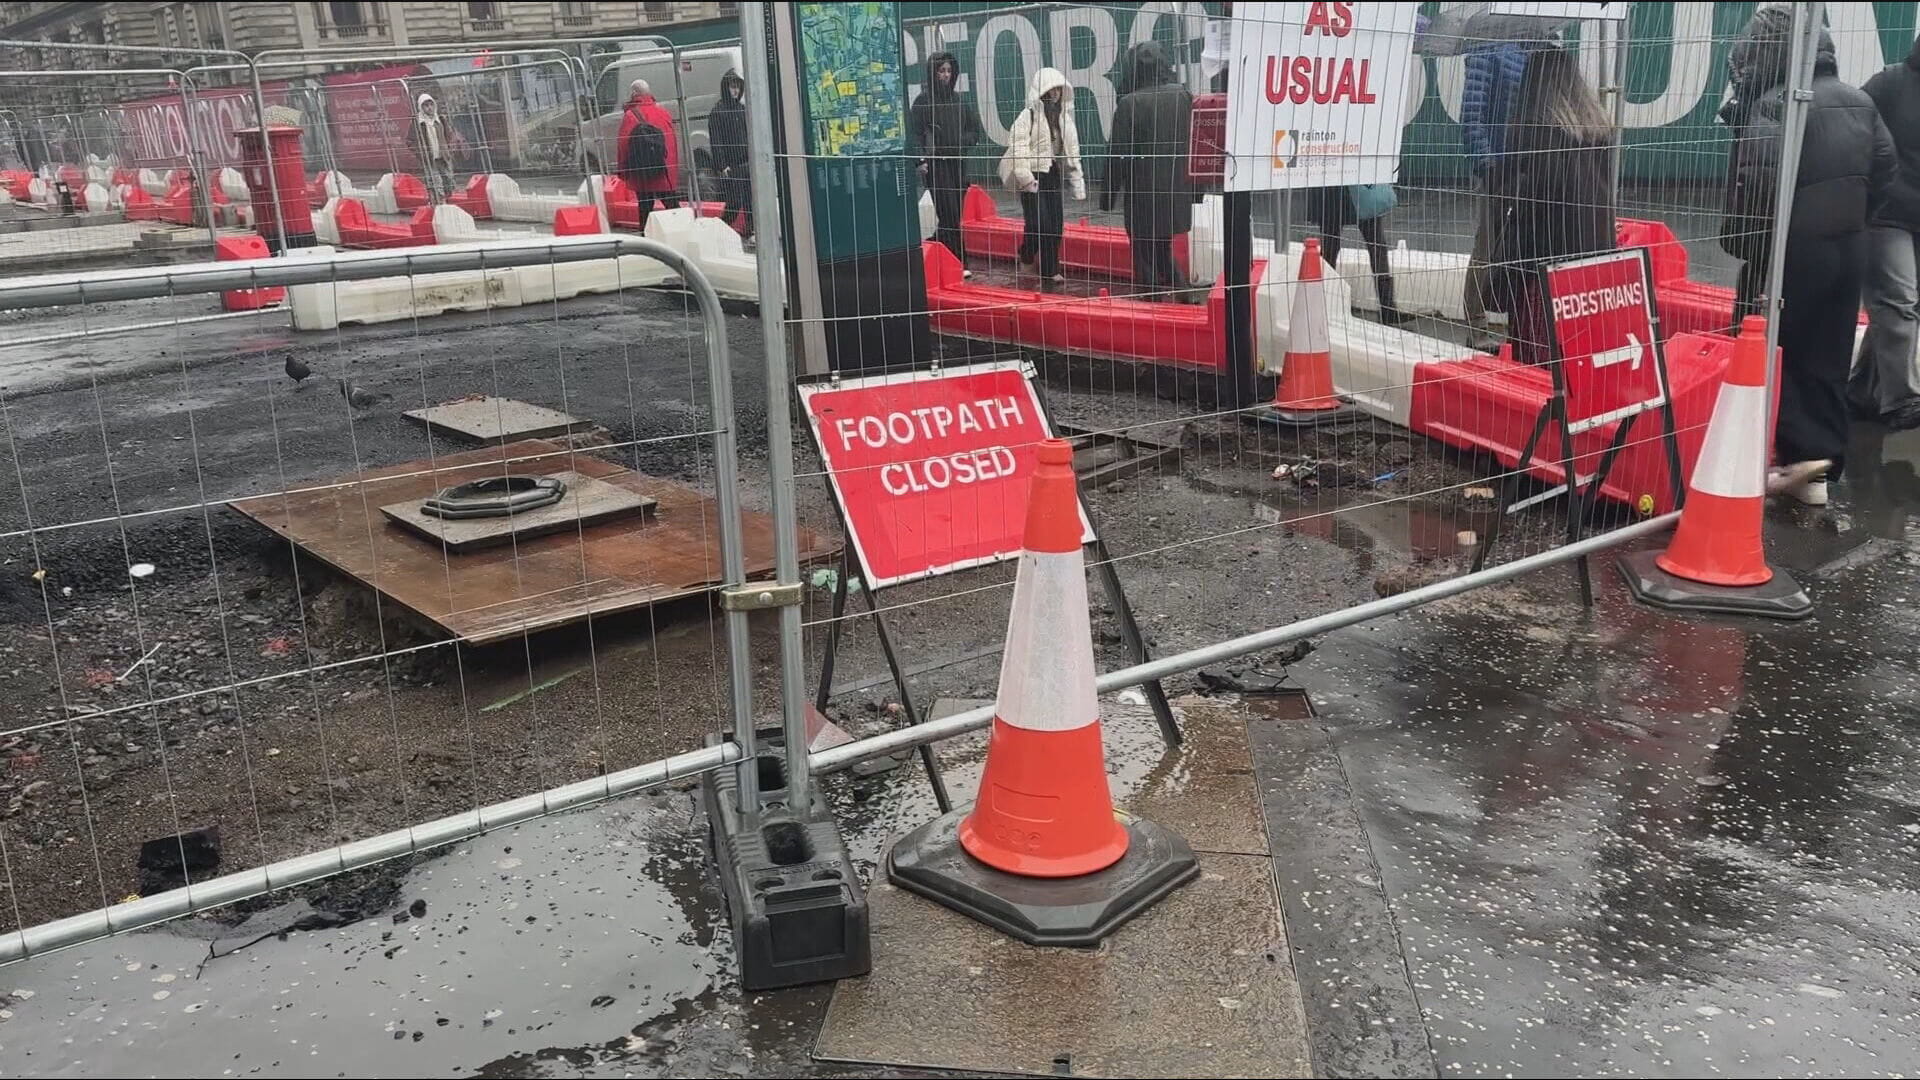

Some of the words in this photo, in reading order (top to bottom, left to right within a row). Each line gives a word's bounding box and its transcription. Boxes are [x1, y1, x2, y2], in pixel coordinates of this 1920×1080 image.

[1304, 2, 1353, 38] AS
[1265, 55, 1377, 105] USUAL
[1300, 142, 1360, 155] construction
[1301, 129, 1336, 142] rainton
[1552, 282, 1643, 322] PEDESTRIANS
[835, 396, 1024, 451] FOOTPATH
[880, 445, 1016, 496] CLOSED
